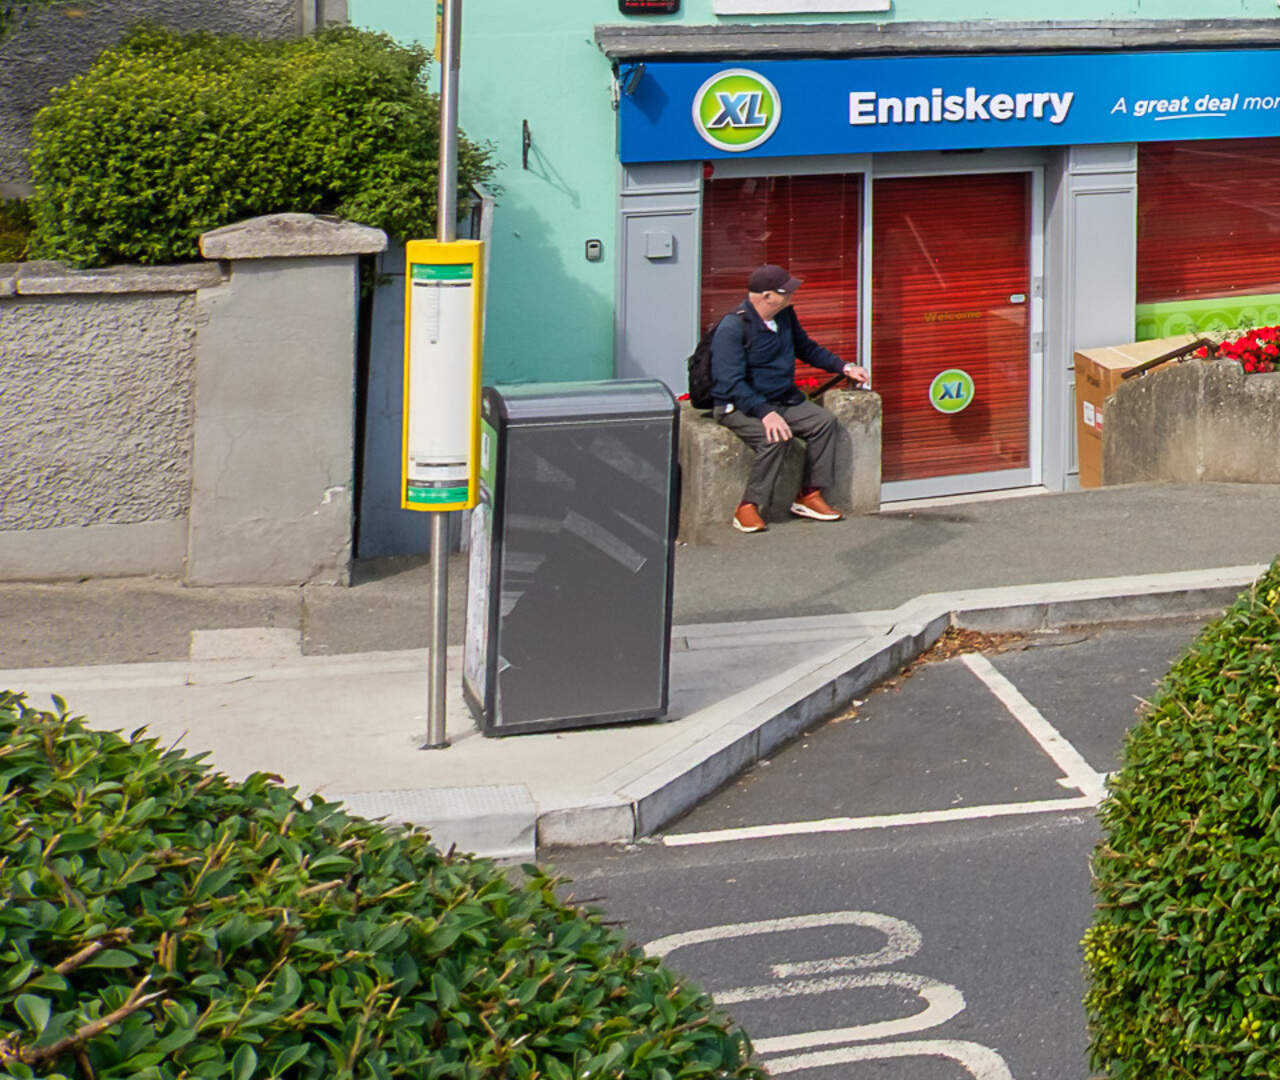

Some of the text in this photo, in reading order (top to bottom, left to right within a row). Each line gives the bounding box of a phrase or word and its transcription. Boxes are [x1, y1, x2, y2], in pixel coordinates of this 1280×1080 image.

[706, 90, 769, 129] XL
[849, 87, 1074, 126] Enniskerry
[1110, 97, 1128, 115] A
[1133, 95, 1189, 116] great
[1194, 92, 1239, 113] deal
[924, 311, 982, 322] Welcome
[938, 381, 965, 400] XL
